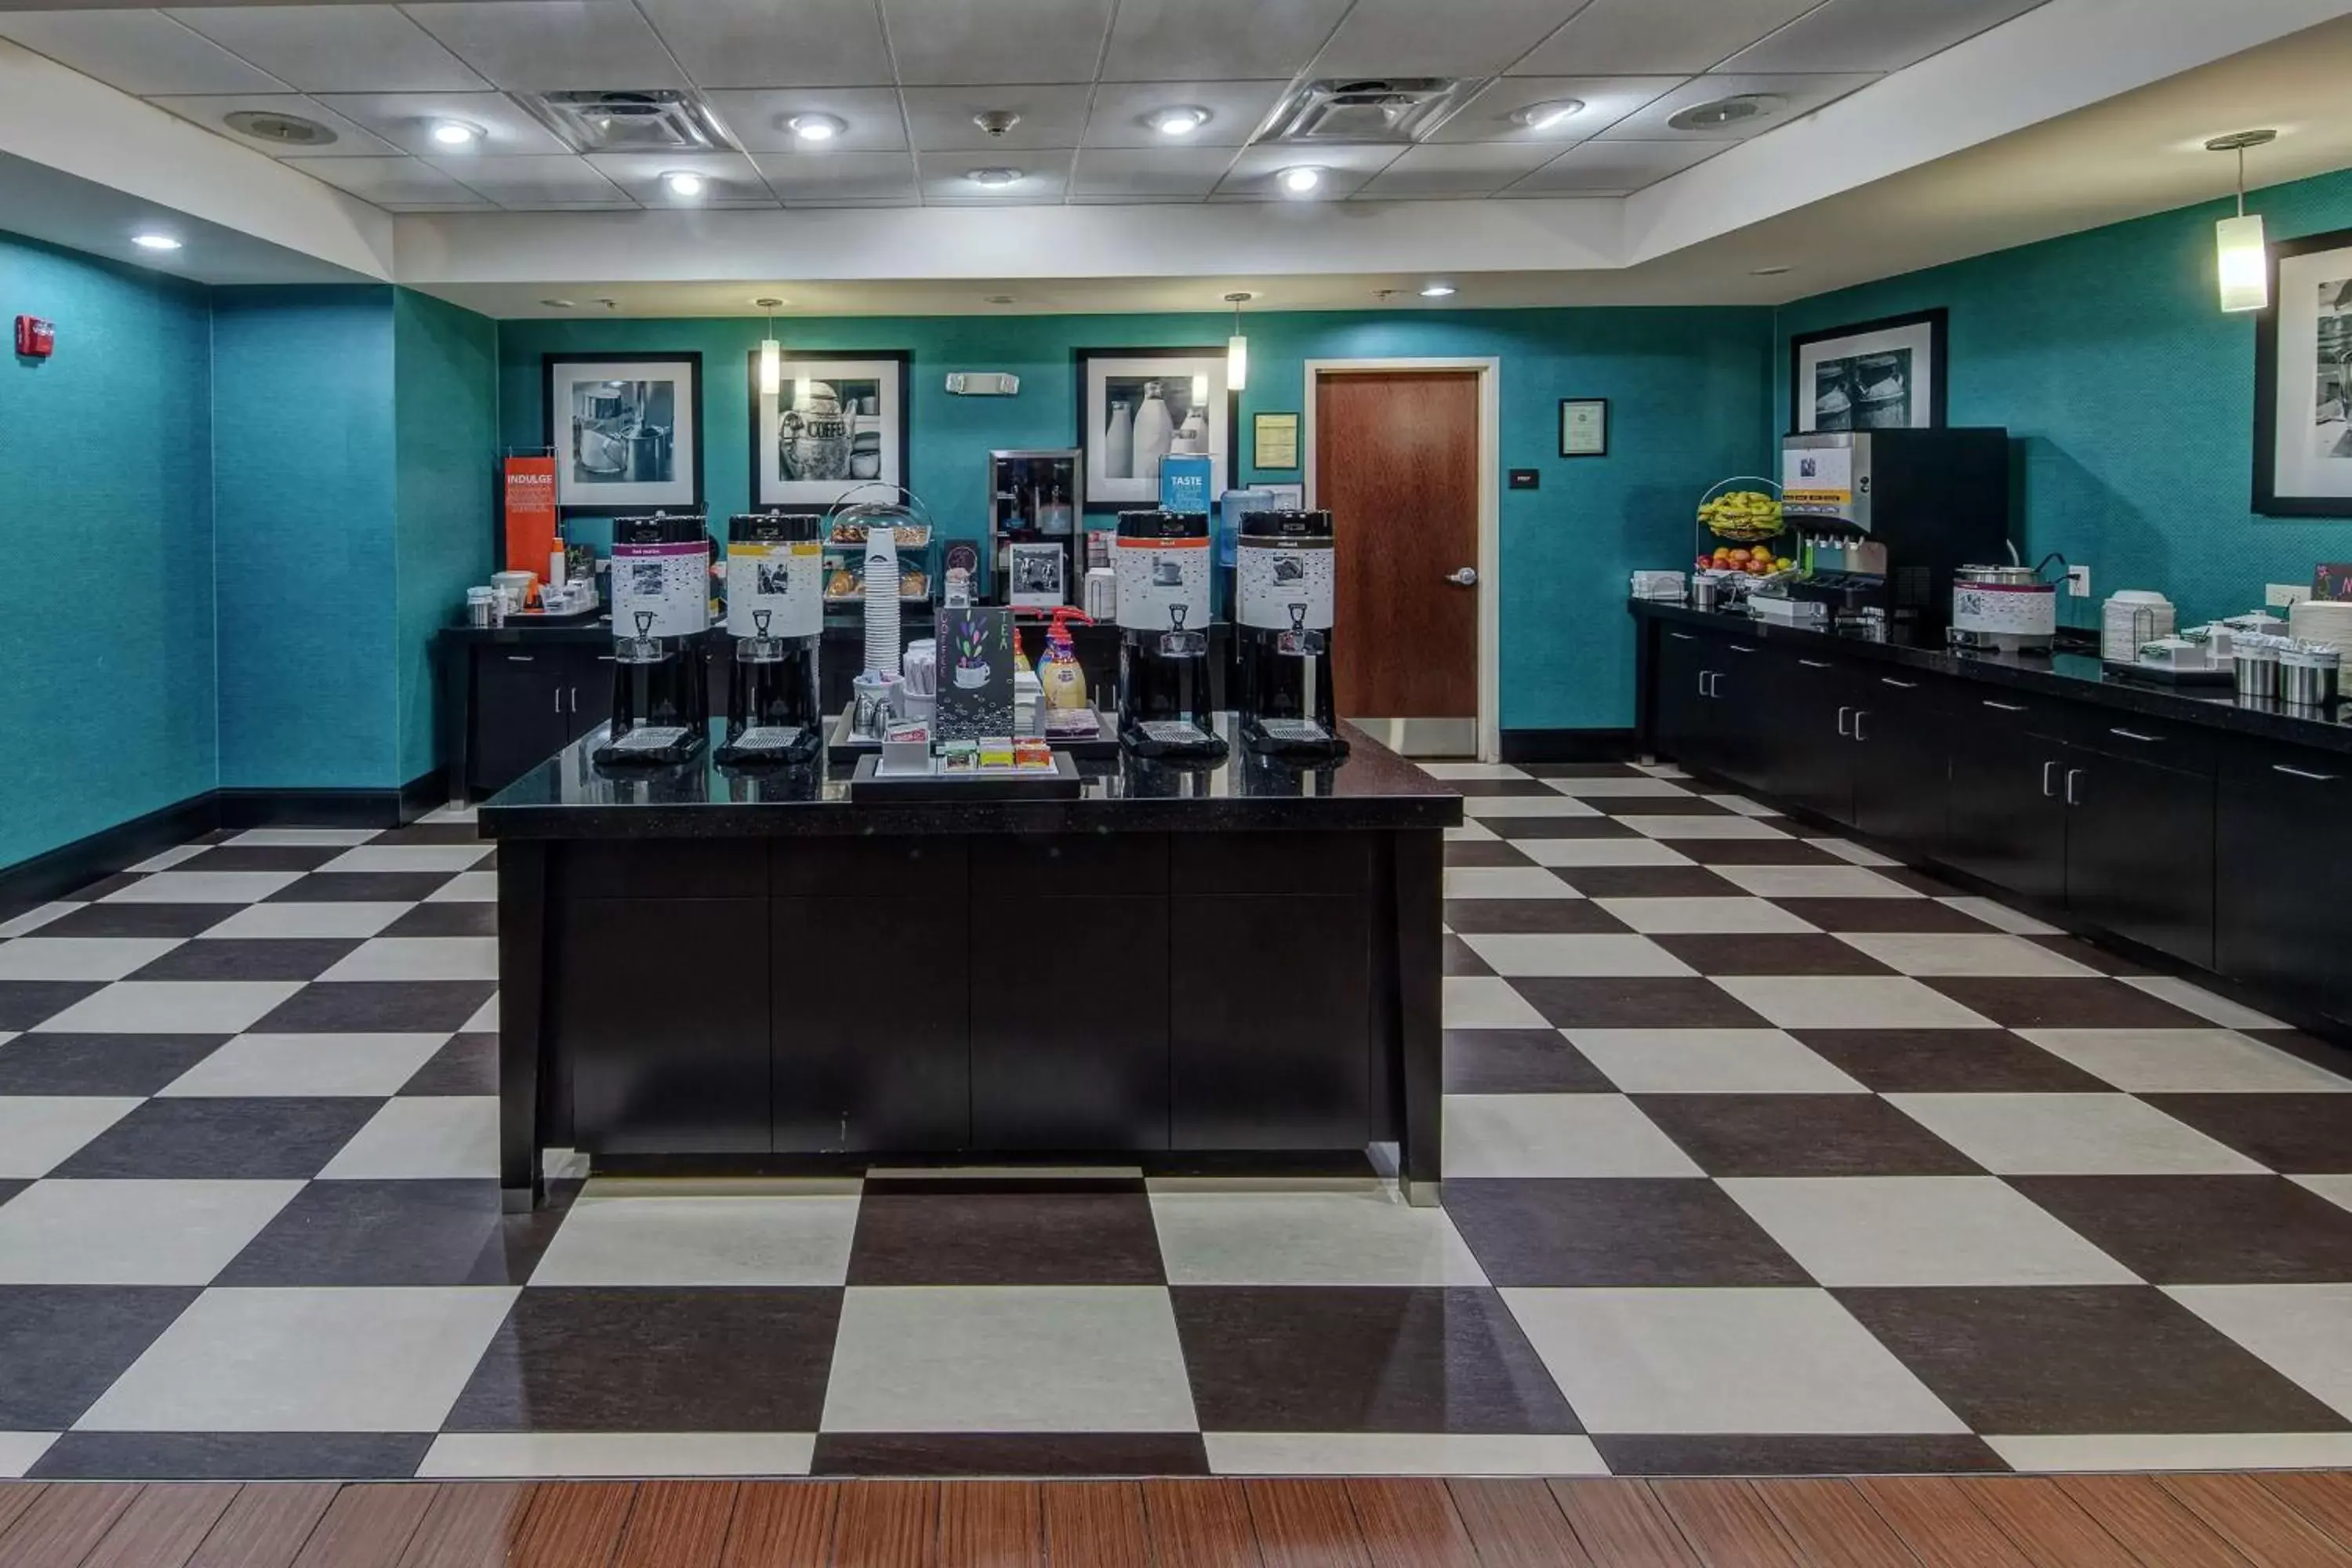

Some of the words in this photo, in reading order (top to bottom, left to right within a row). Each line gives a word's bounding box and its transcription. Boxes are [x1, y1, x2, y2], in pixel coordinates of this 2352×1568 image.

[507, 474, 552, 484] INDULGE
[1171, 476, 1202, 485] TASTE
[998, 611, 1009, 650] TEA
